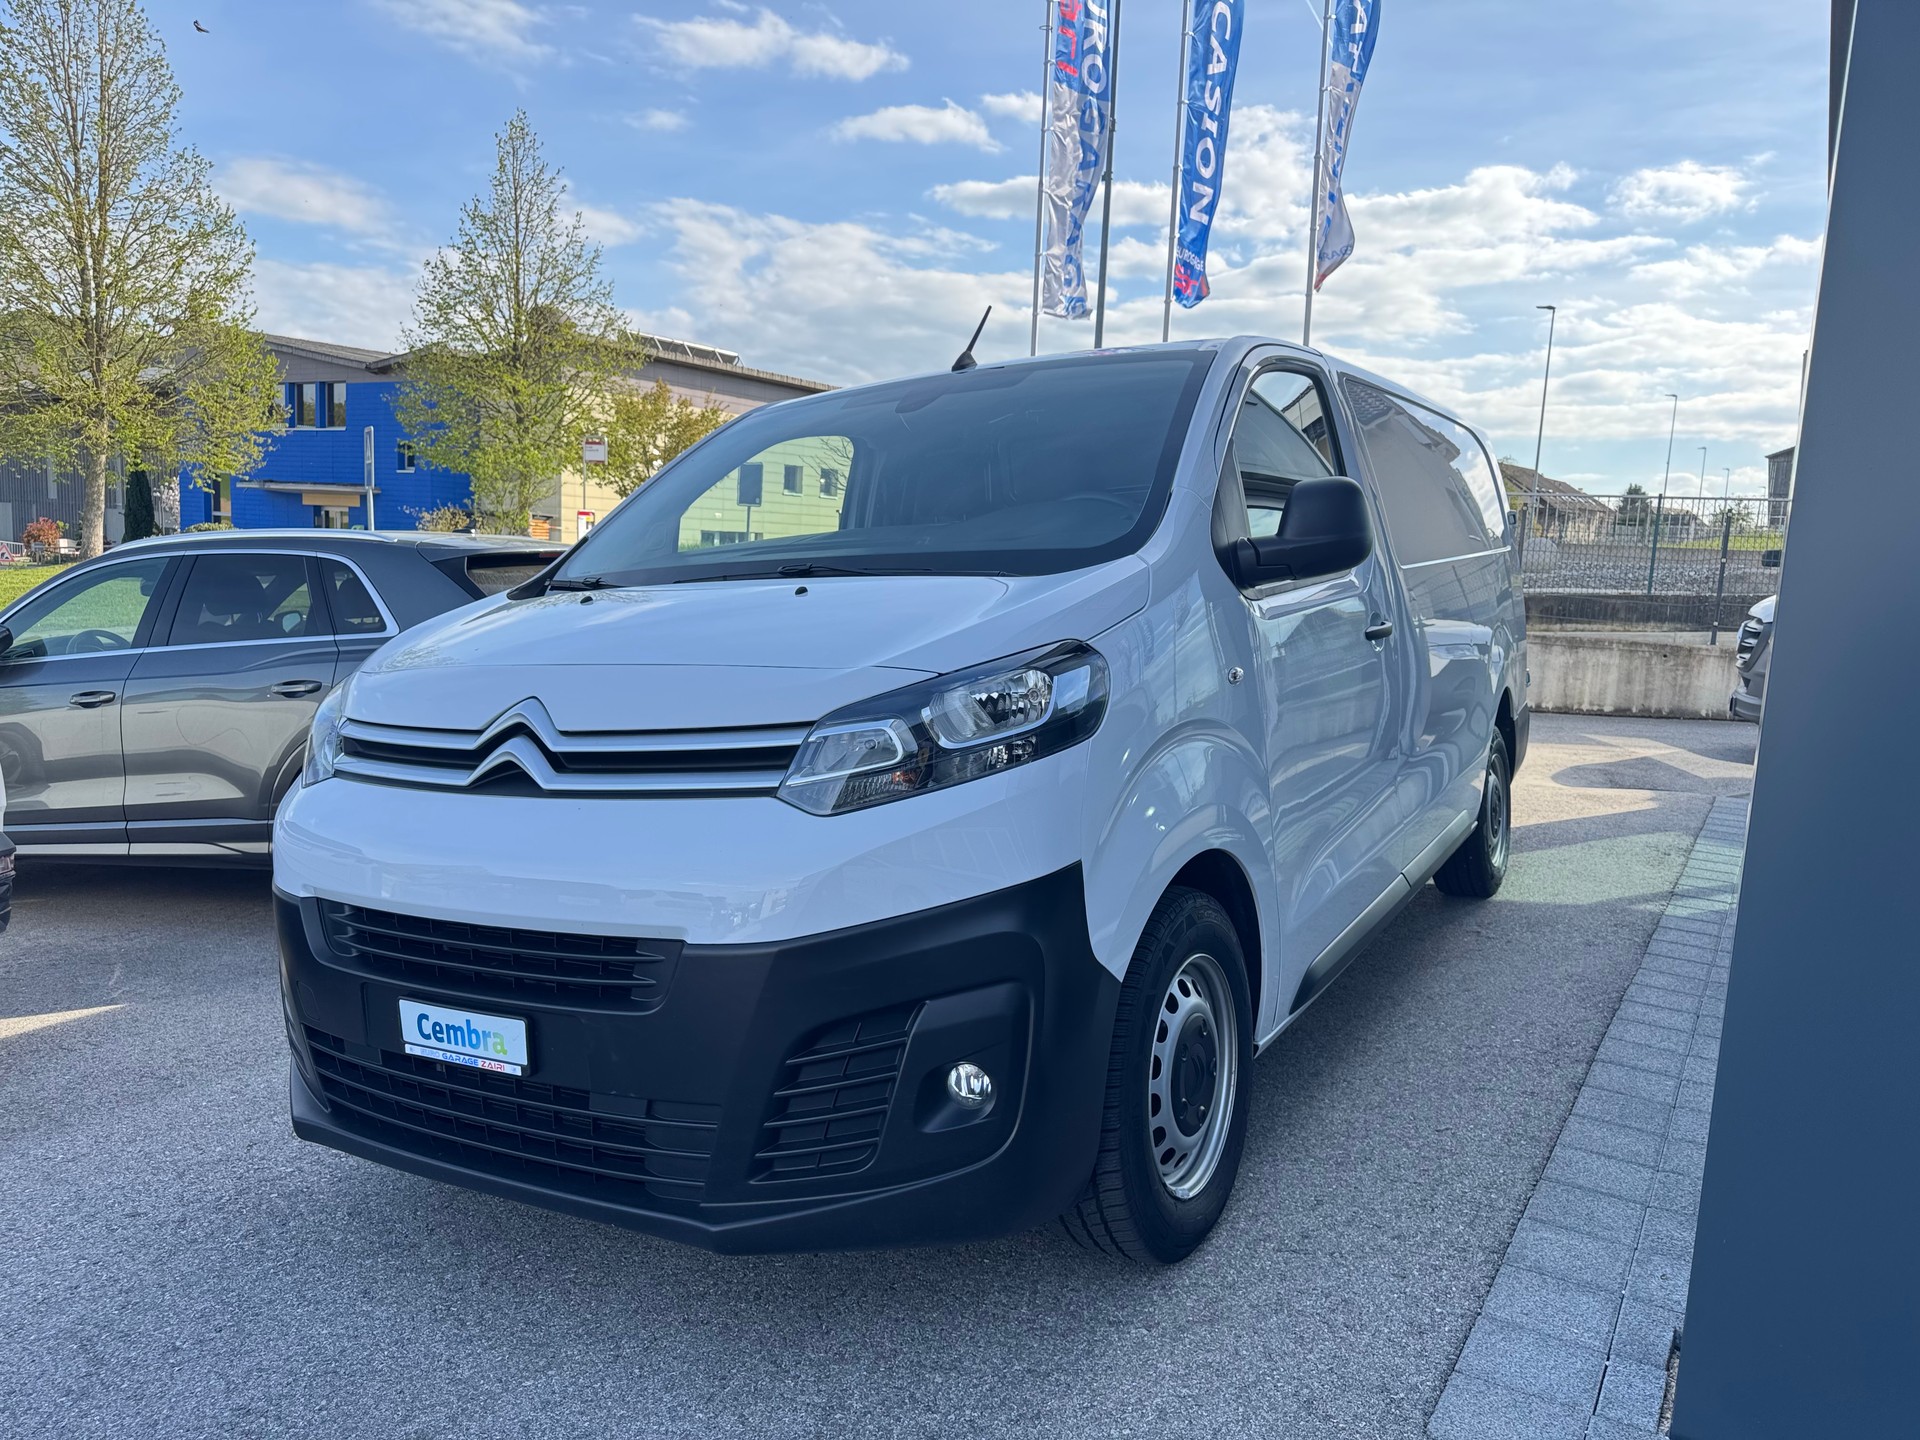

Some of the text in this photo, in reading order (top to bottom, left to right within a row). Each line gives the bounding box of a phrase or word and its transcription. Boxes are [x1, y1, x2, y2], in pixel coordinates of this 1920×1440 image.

[1189, 0, 1234, 226] CASION
[417, 1013, 508, 1055] Cembra
[441, 1052, 479, 1067] GARAGE
[480, 1060, 506, 1072] ZAIRI
